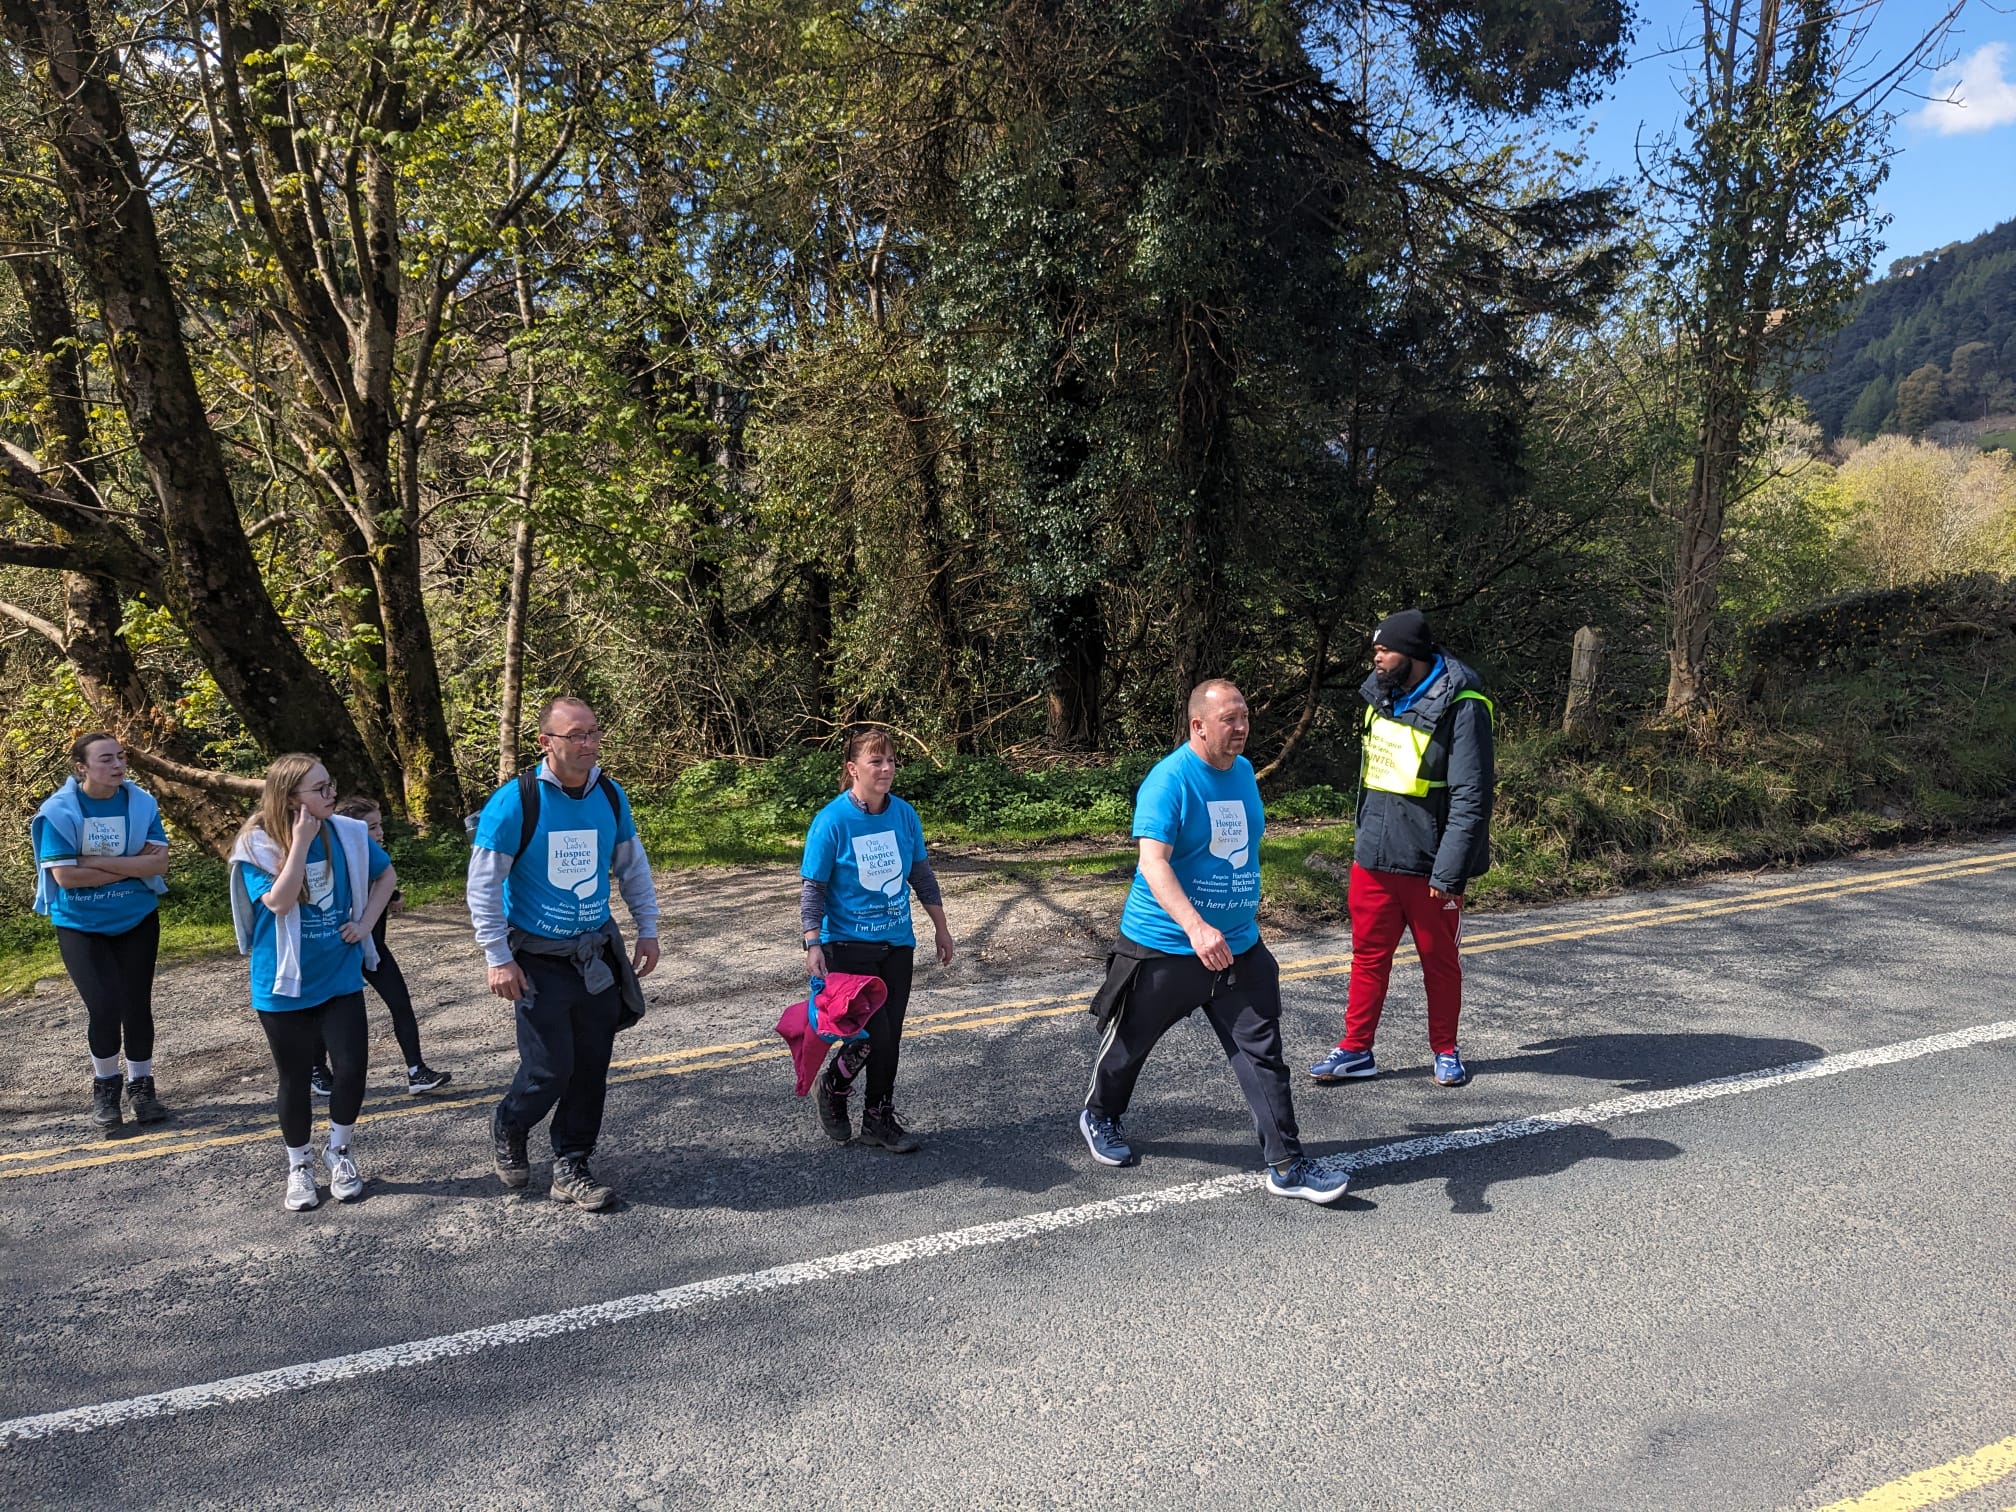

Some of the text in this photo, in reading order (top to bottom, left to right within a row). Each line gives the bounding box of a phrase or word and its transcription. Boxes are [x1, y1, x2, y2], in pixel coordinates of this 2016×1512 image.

[1216, 819, 1242, 829] Hospice
[1228, 828, 1242, 836] Care
[88, 833, 120, 842] Hospice
[566, 842, 587, 850] Lady's
[869, 844, 889, 852] Lady's
[554, 850, 591, 859] Hospice
[861, 851, 894, 862] Hospice
[561, 858, 591, 867] & Care
[869, 858, 896, 869] & Care
[866, 868, 893, 877] Services
[75, 892, 91, 901] here
[93, 892, 106, 902] for
[1189, 897, 1204, 907] I'm
[1206, 898, 1226, 909] here
[1226, 899, 1239, 911] for
[536, 919, 552, 931] I'm
[552, 924, 571, 936] here
[855, 923, 869, 932] I'm
[870, 921, 887, 932] here
[886, 919, 897, 930] for
